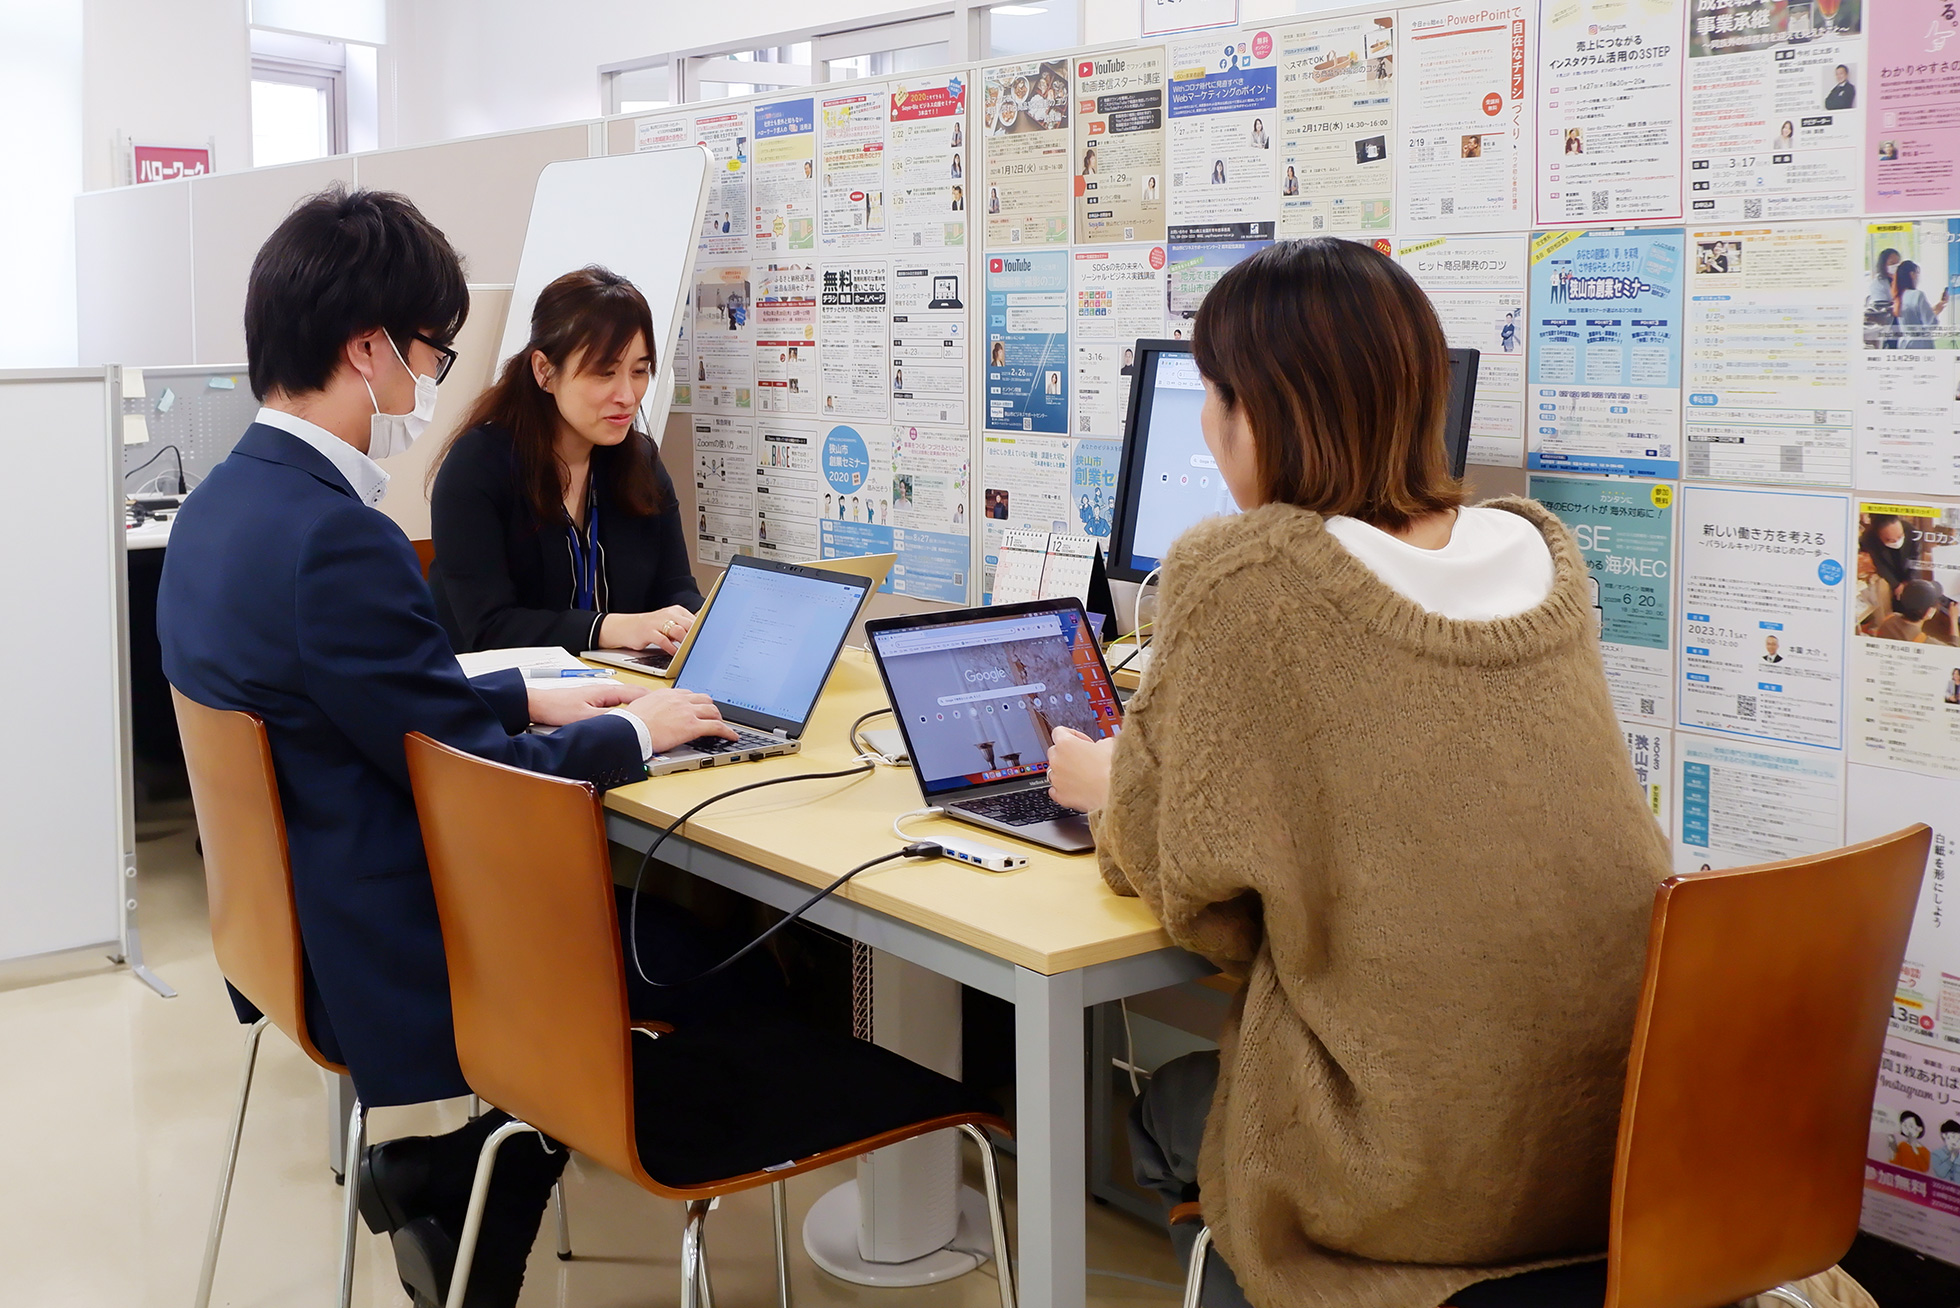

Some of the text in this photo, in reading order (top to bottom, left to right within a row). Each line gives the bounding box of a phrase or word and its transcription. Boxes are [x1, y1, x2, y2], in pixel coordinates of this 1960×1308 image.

[1447, 6, 1522, 26] PowerPointで
[1696, 8, 1771, 36] 事業承継
[1598, 24, 1626, 32] Instagram
[1257, 36, 1268, 44] 無料
[1576, 35, 1642, 52] 売上につながる
[1549, 46, 1670, 70] インスタグラム活用の3STEP
[1094, 58, 1126, 75] YouTube
[1082, 72, 1160, 93] 動画発信スタート講座
[1173, 78, 1244, 92] Withコロナ時代に見直すべき
[910, 93, 926, 102] 2020
[1173, 84, 1272, 103] Webマーケティングのポイント
[1302, 122, 1343, 133] 2月17日(水)
[140, 160, 204, 181] ハローワーク
[1377, 241, 1391, 252] 7/15
[1004, 258, 1032, 272] YouTube
[1418, 260, 1507, 272] ヒット商品開発のコツ
[824, 270, 853, 292] 無料
[1081, 272, 1156, 281] ソーシャル・ビジネス実践講座
[853, 284, 886, 292] 使いこなして
[895, 282, 910, 290] Zoom
[1569, 278, 1650, 299] 狭山市創業セミナー
[823, 294, 837, 302] チラシ
[854, 294, 884, 303] ホームページ
[696, 438, 734, 450] Zoomの使い方
[828, 444, 848, 455] 狭山市
[772, 444, 790, 468] BASE
[1076, 456, 1102, 466] 狭山市
[828, 457, 868, 468] 創業セミナー
[828, 471, 850, 482] 2020
[1074, 466, 1116, 487] 創業セ
[1656, 488, 1669, 496] 参加
[1600, 494, 1633, 504] カンタンに
[1006, 536, 1014, 546] 11
[1702, 524, 1826, 546] 新しい働き方を考える
[1052, 540, 1062, 552] 12
[1604, 554, 1668, 578] 海外EC
[1696, 636, 1738, 648] 10:00-12:00
[964, 666, 1006, 684] Google
[1934, 834, 1946, 928] 白紙を形にしよう
